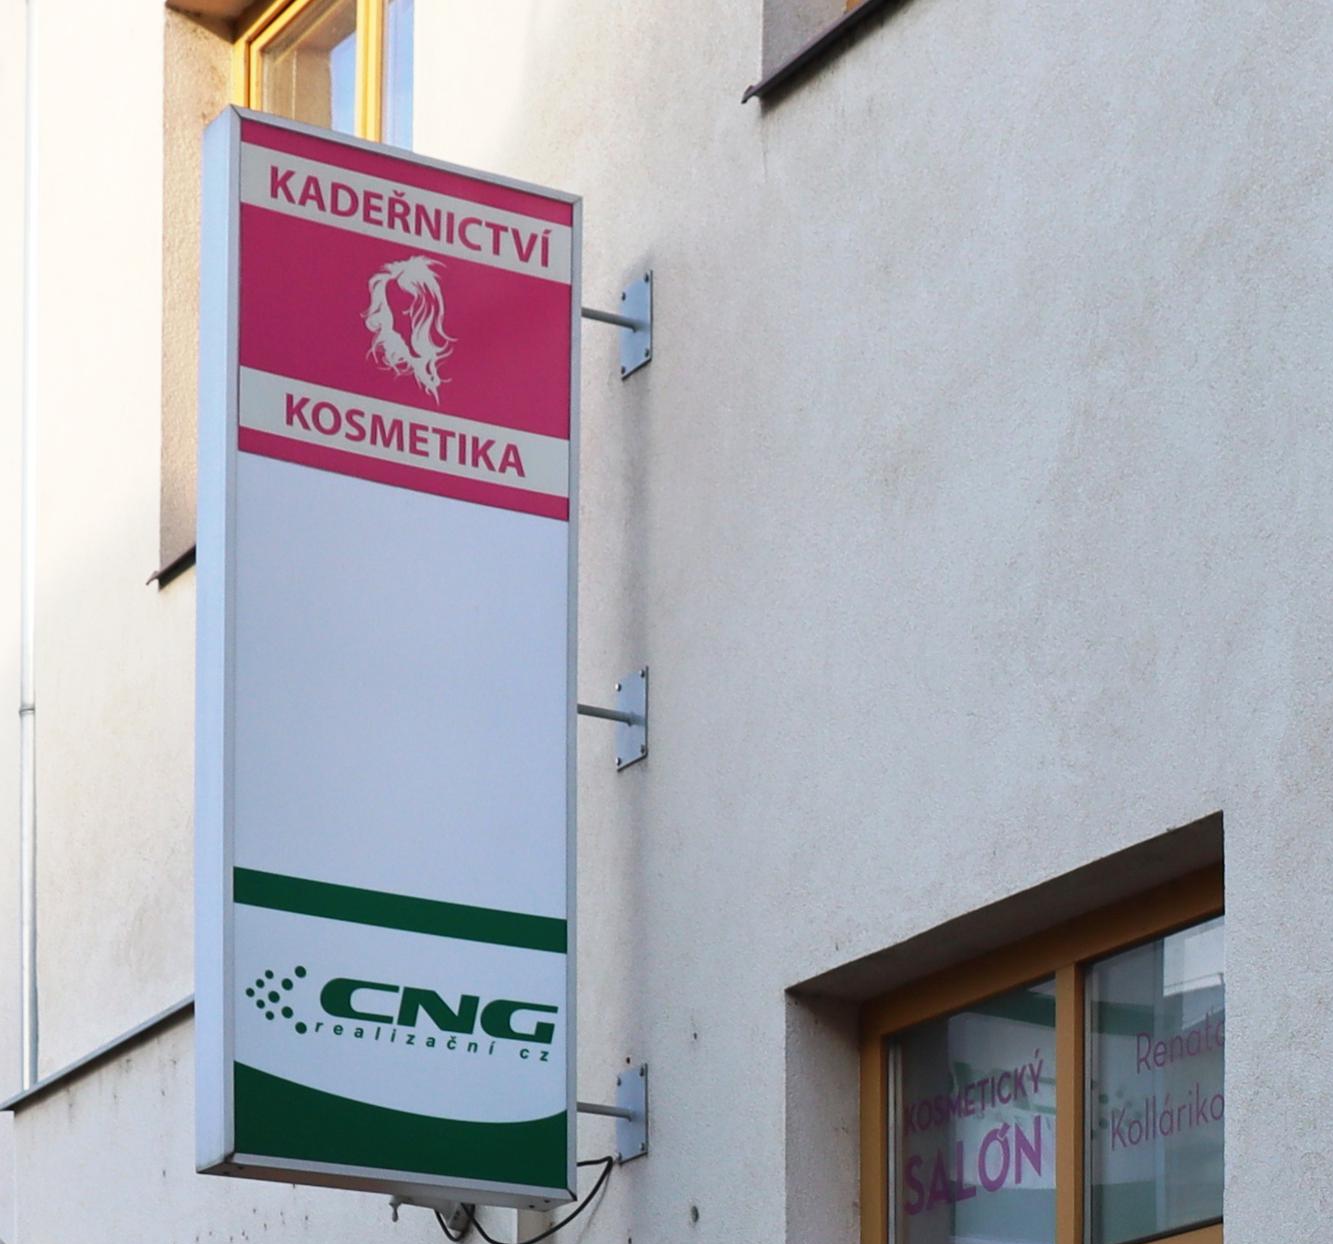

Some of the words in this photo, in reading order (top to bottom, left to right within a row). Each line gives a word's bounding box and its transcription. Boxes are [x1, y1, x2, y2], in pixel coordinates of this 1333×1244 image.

[269, 164, 551, 268] KADEŘNICTVÍ
[284, 393, 526, 478] KOSMETIKA
[319, 977, 559, 1045] CNG
[904, 1048, 1043, 1137] KOSMETICKÝ
[904, 1115, 1042, 1216] SALÓN
